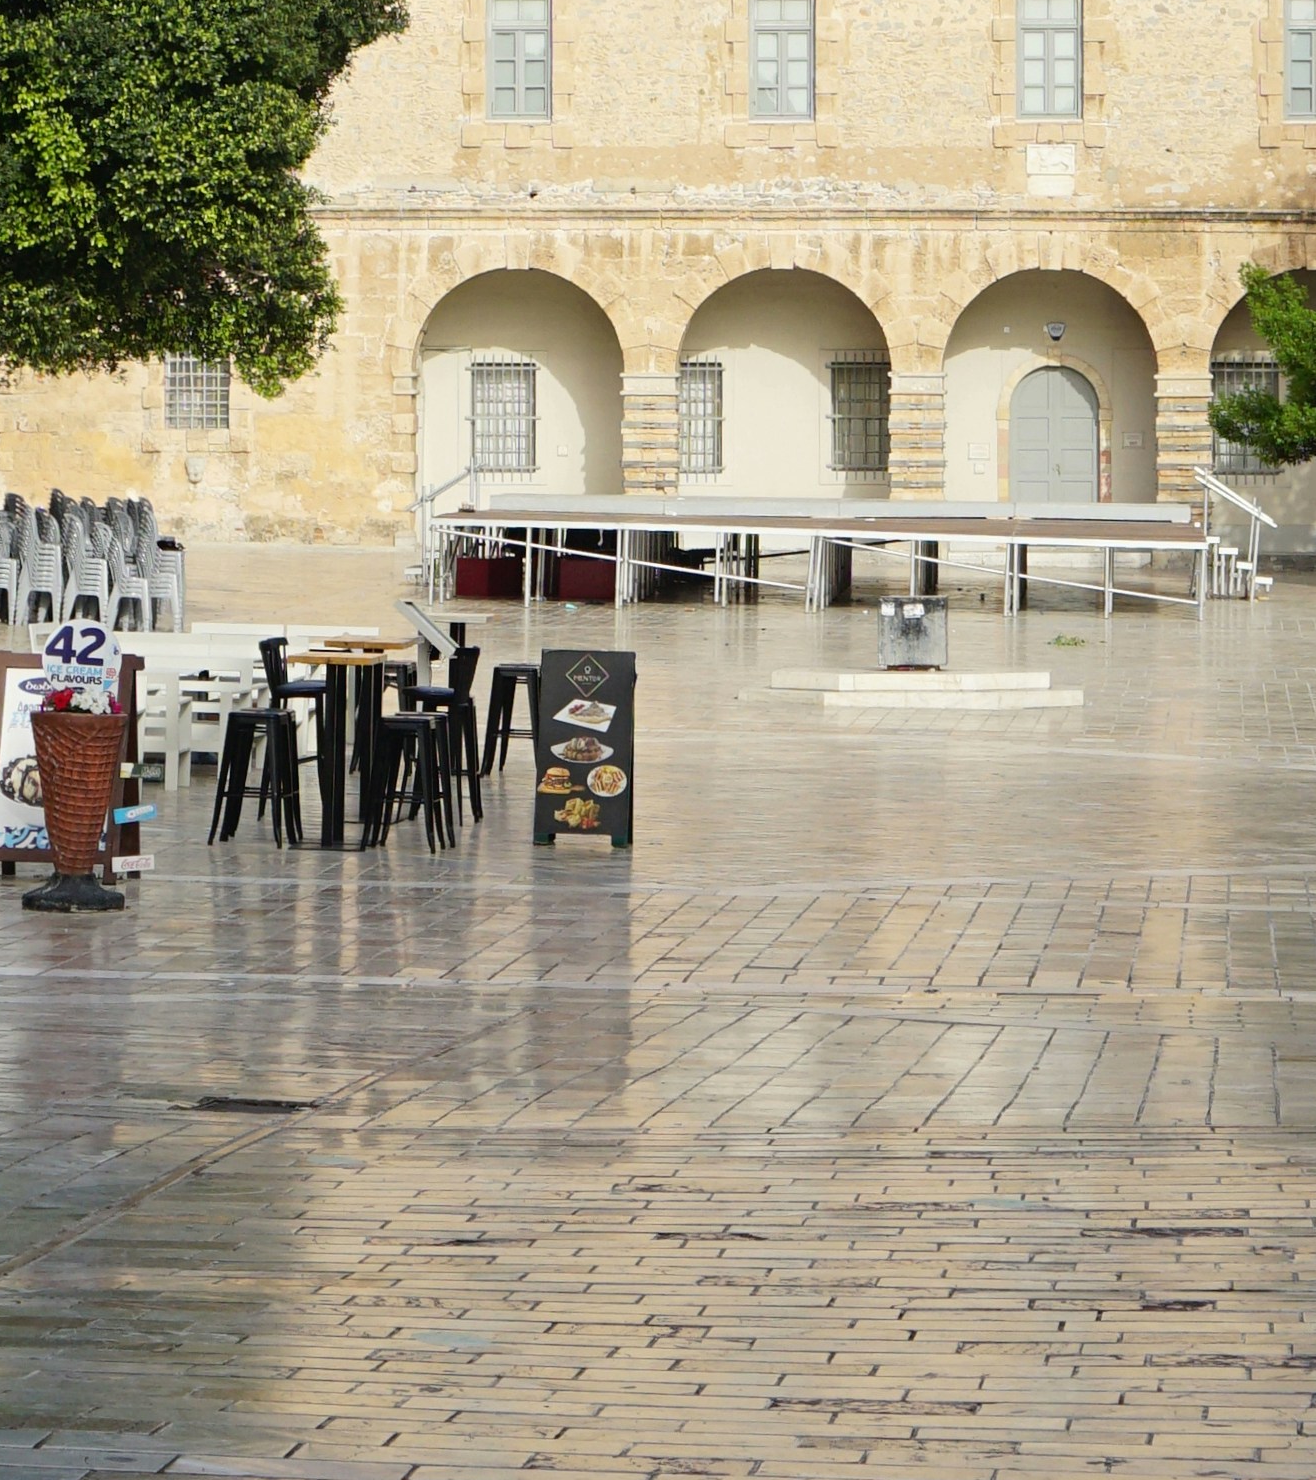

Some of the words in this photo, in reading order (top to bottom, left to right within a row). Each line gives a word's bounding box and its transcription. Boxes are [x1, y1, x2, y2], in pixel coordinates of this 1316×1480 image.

[45, 625, 106, 666] 42
[46, 665, 62, 673] ICE
[65, 666, 103, 676] CREAM
[50, 674, 102, 685] FLAVOURS
